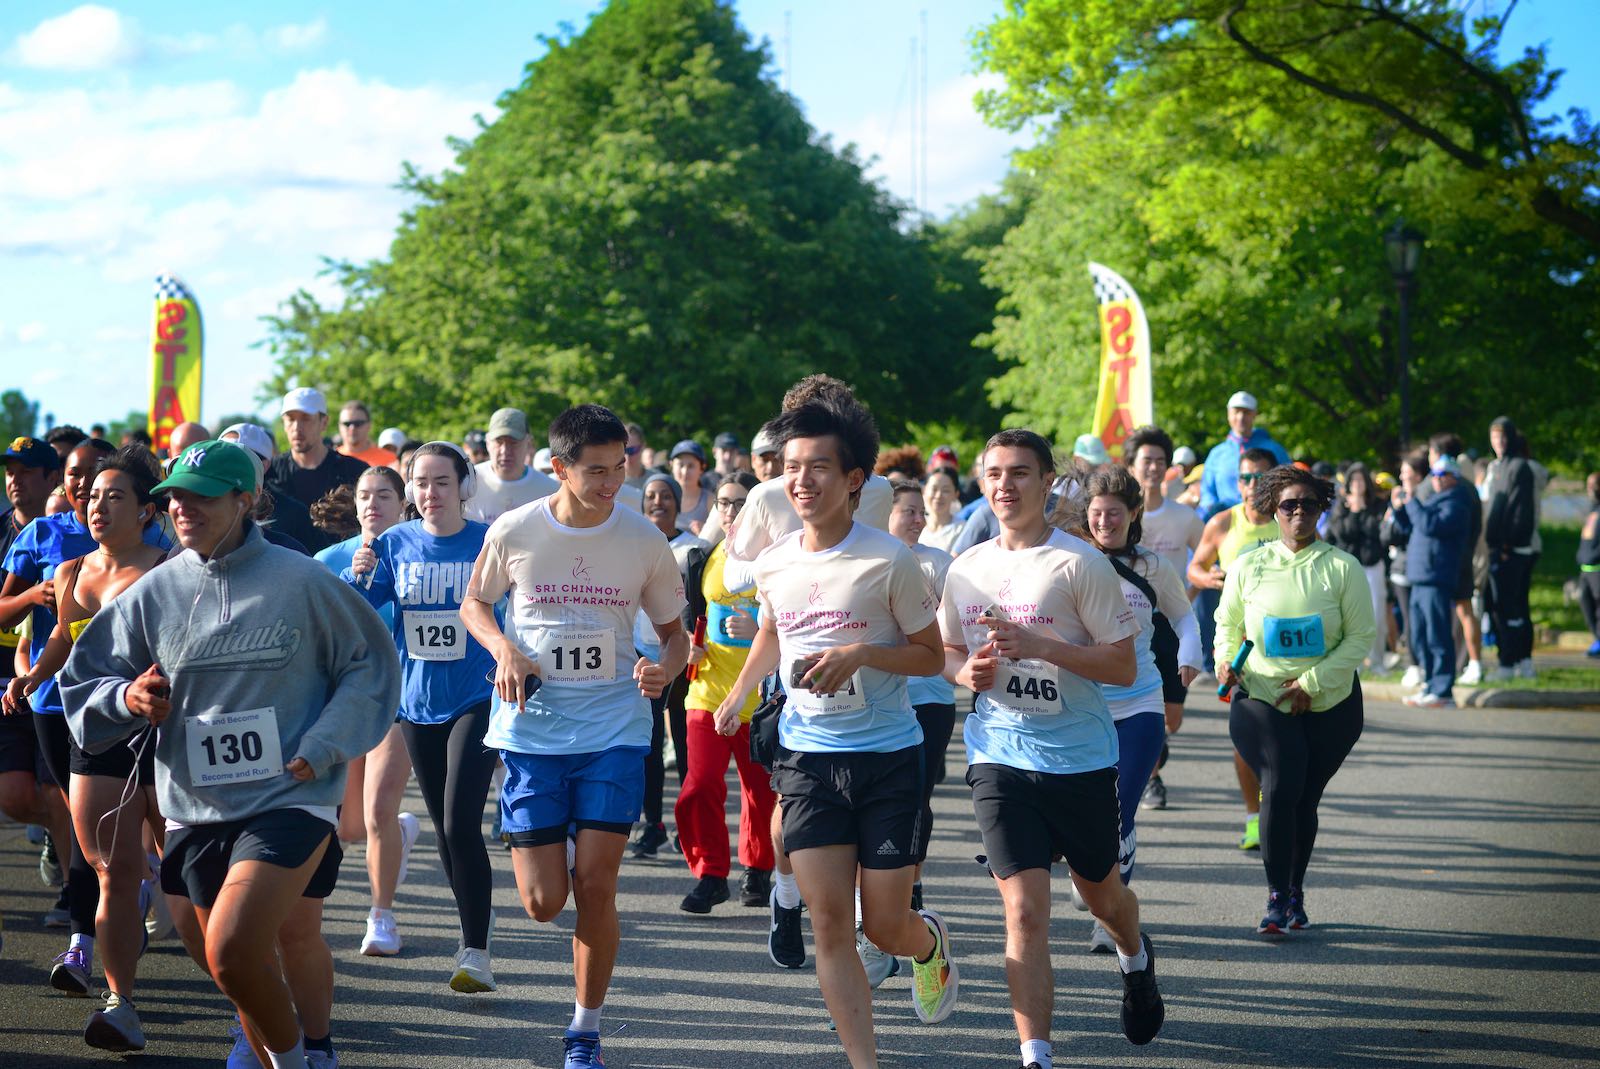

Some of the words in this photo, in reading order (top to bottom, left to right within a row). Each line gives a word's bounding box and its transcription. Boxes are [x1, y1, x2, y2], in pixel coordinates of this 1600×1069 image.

[400, 561, 475, 605] ESOPU
[535, 584, 556, 593] SRI
[561, 584, 621, 596] CHINMOY
[780, 611, 796, 620] SRI
[966, 605, 983, 614] SRI
[415, 625, 456, 647] 129
[1280, 627, 1318, 647] 61C
[551, 646, 602, 670] 113
[1006, 675, 1058, 702] 446
[212, 717, 226, 726] and
[227, 714, 260, 724] Become
[201, 731, 263, 766] 130
[201, 773, 234, 782] Become
[235, 769, 251, 778] and
[252, 767, 270, 776] Run
